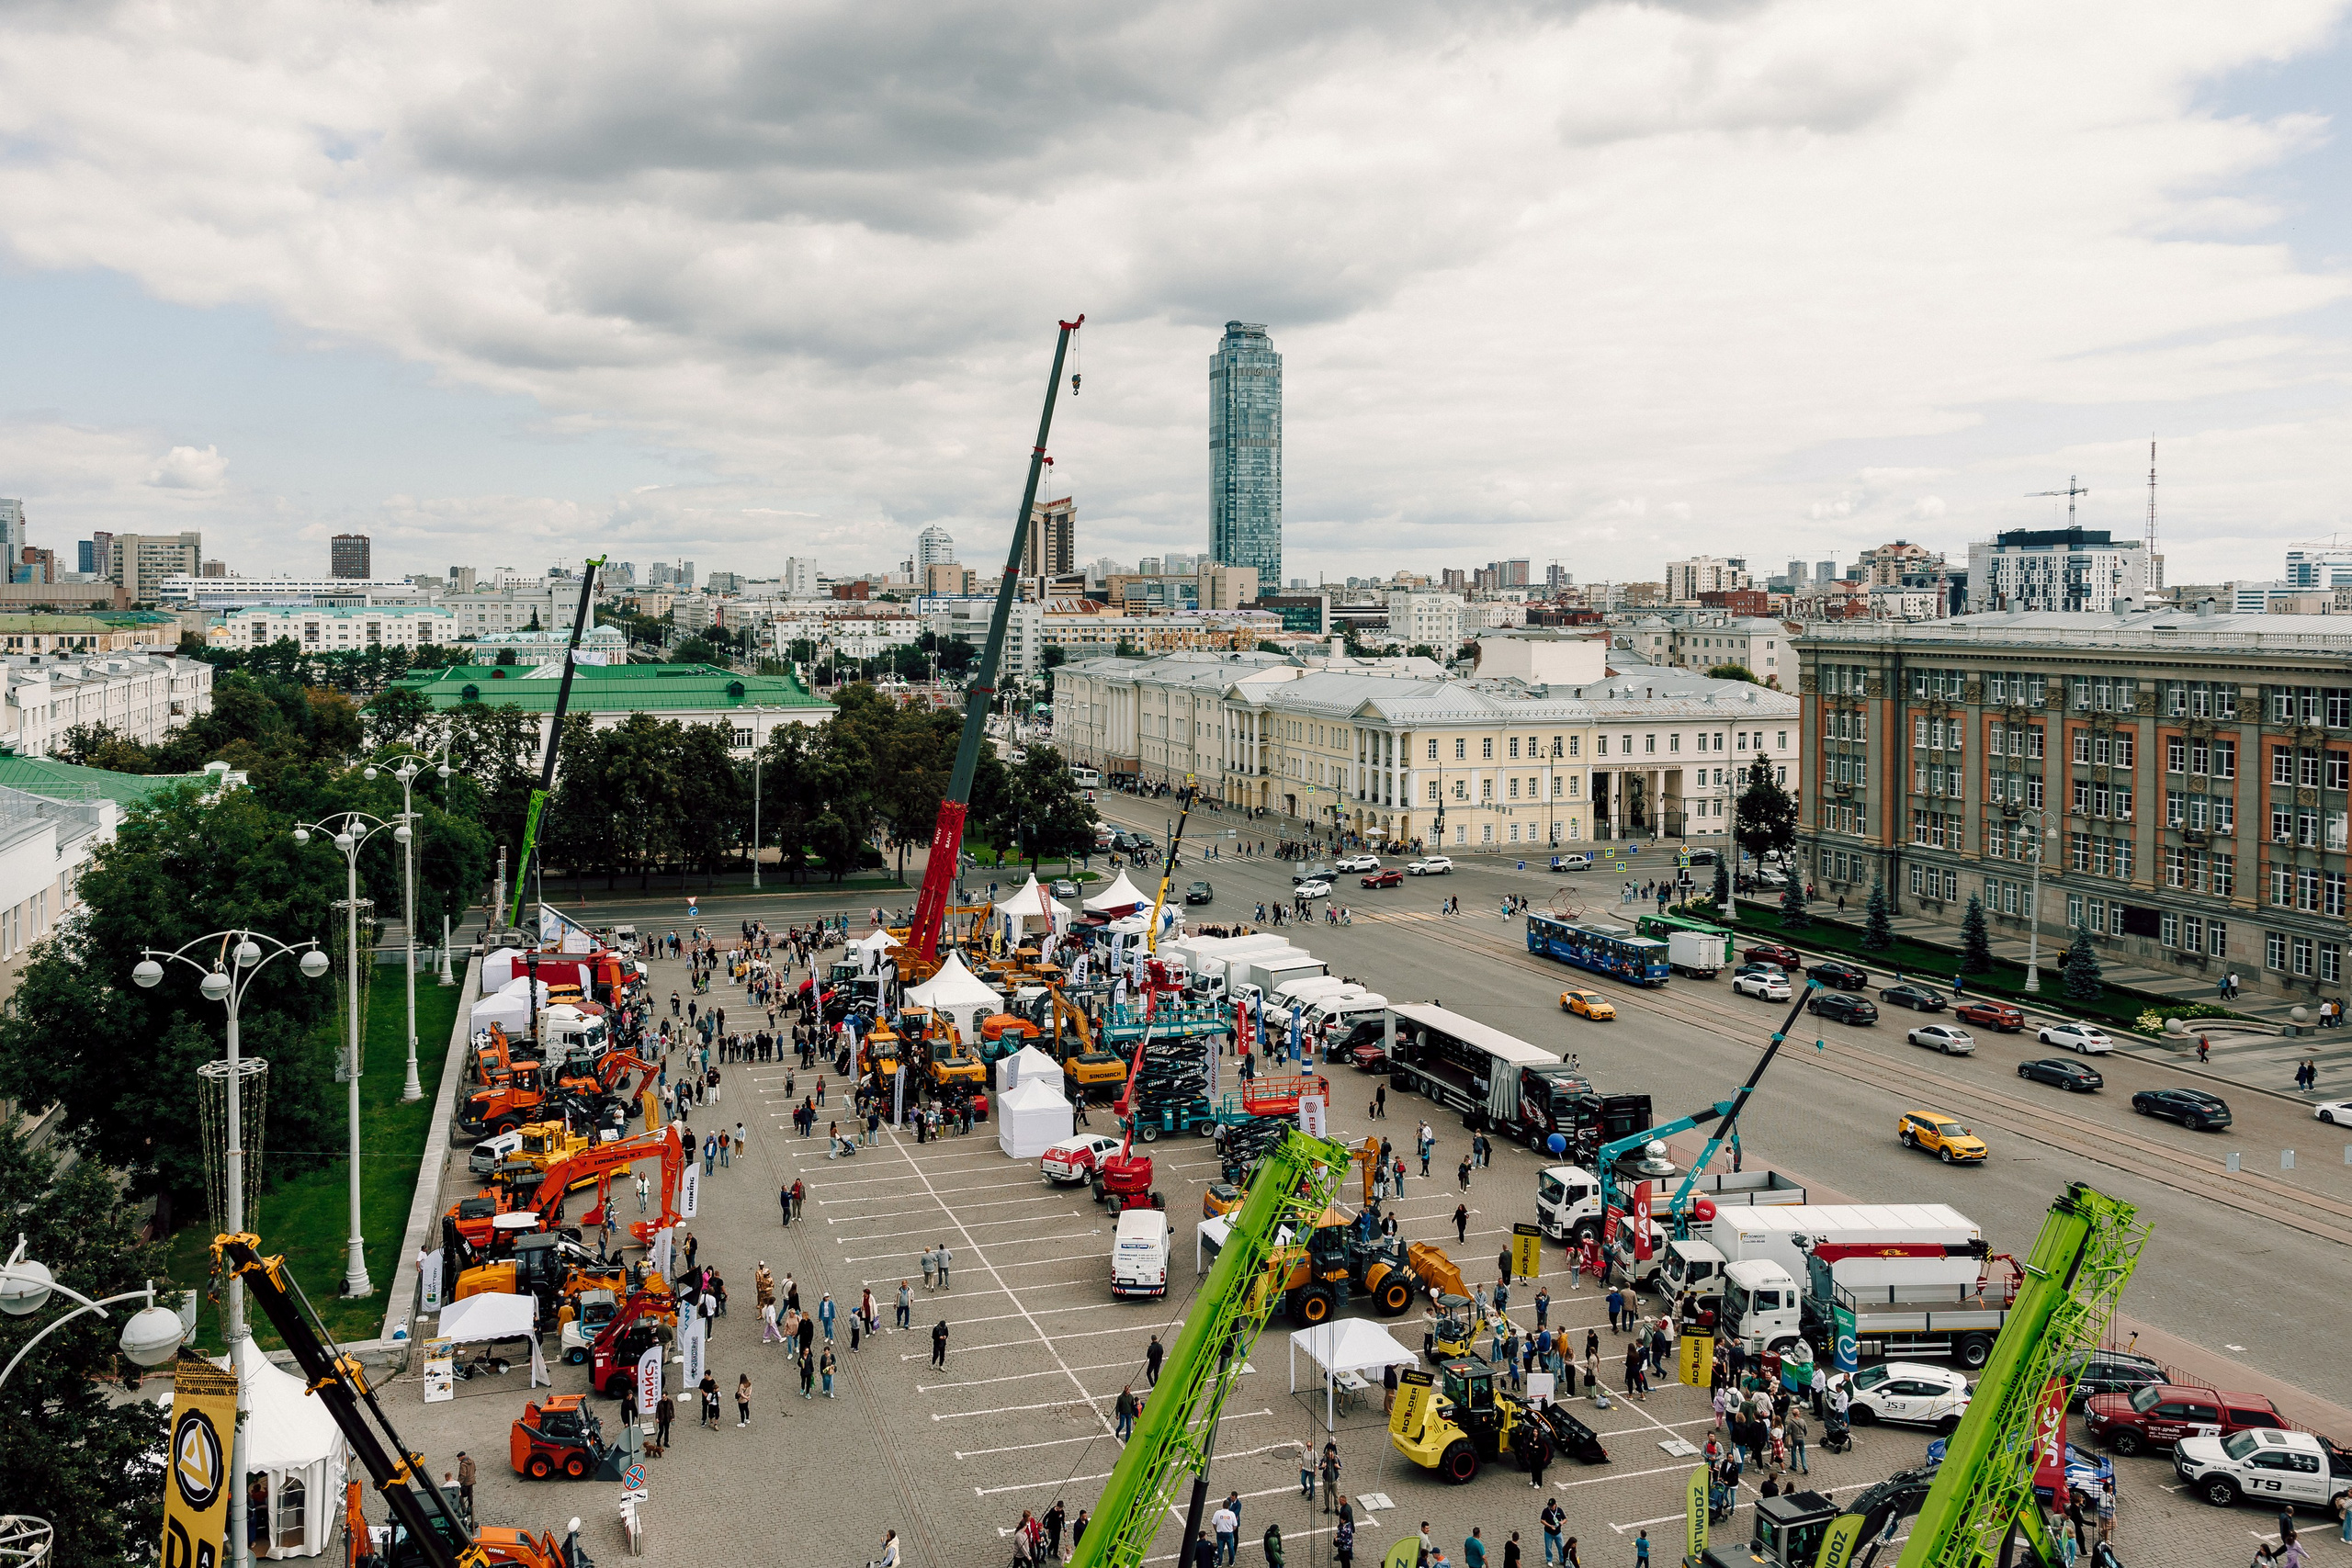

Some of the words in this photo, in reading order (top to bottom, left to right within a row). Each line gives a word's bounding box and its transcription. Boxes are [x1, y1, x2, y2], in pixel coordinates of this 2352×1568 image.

[1148, 1078, 1167, 1088] СЕРВИС
[1638, 1201, 1649, 1247] JAC
[641, 1366, 654, 1408] НАЙС
[1994, 1370, 2021, 1424] ZOOMLION
[1884, 1401, 1906, 1410] JS3
[2041, 1406, 2060, 1467] JAC
[2248, 1477, 2283, 1492] T9
[488, 1547, 506, 1555] UMG
